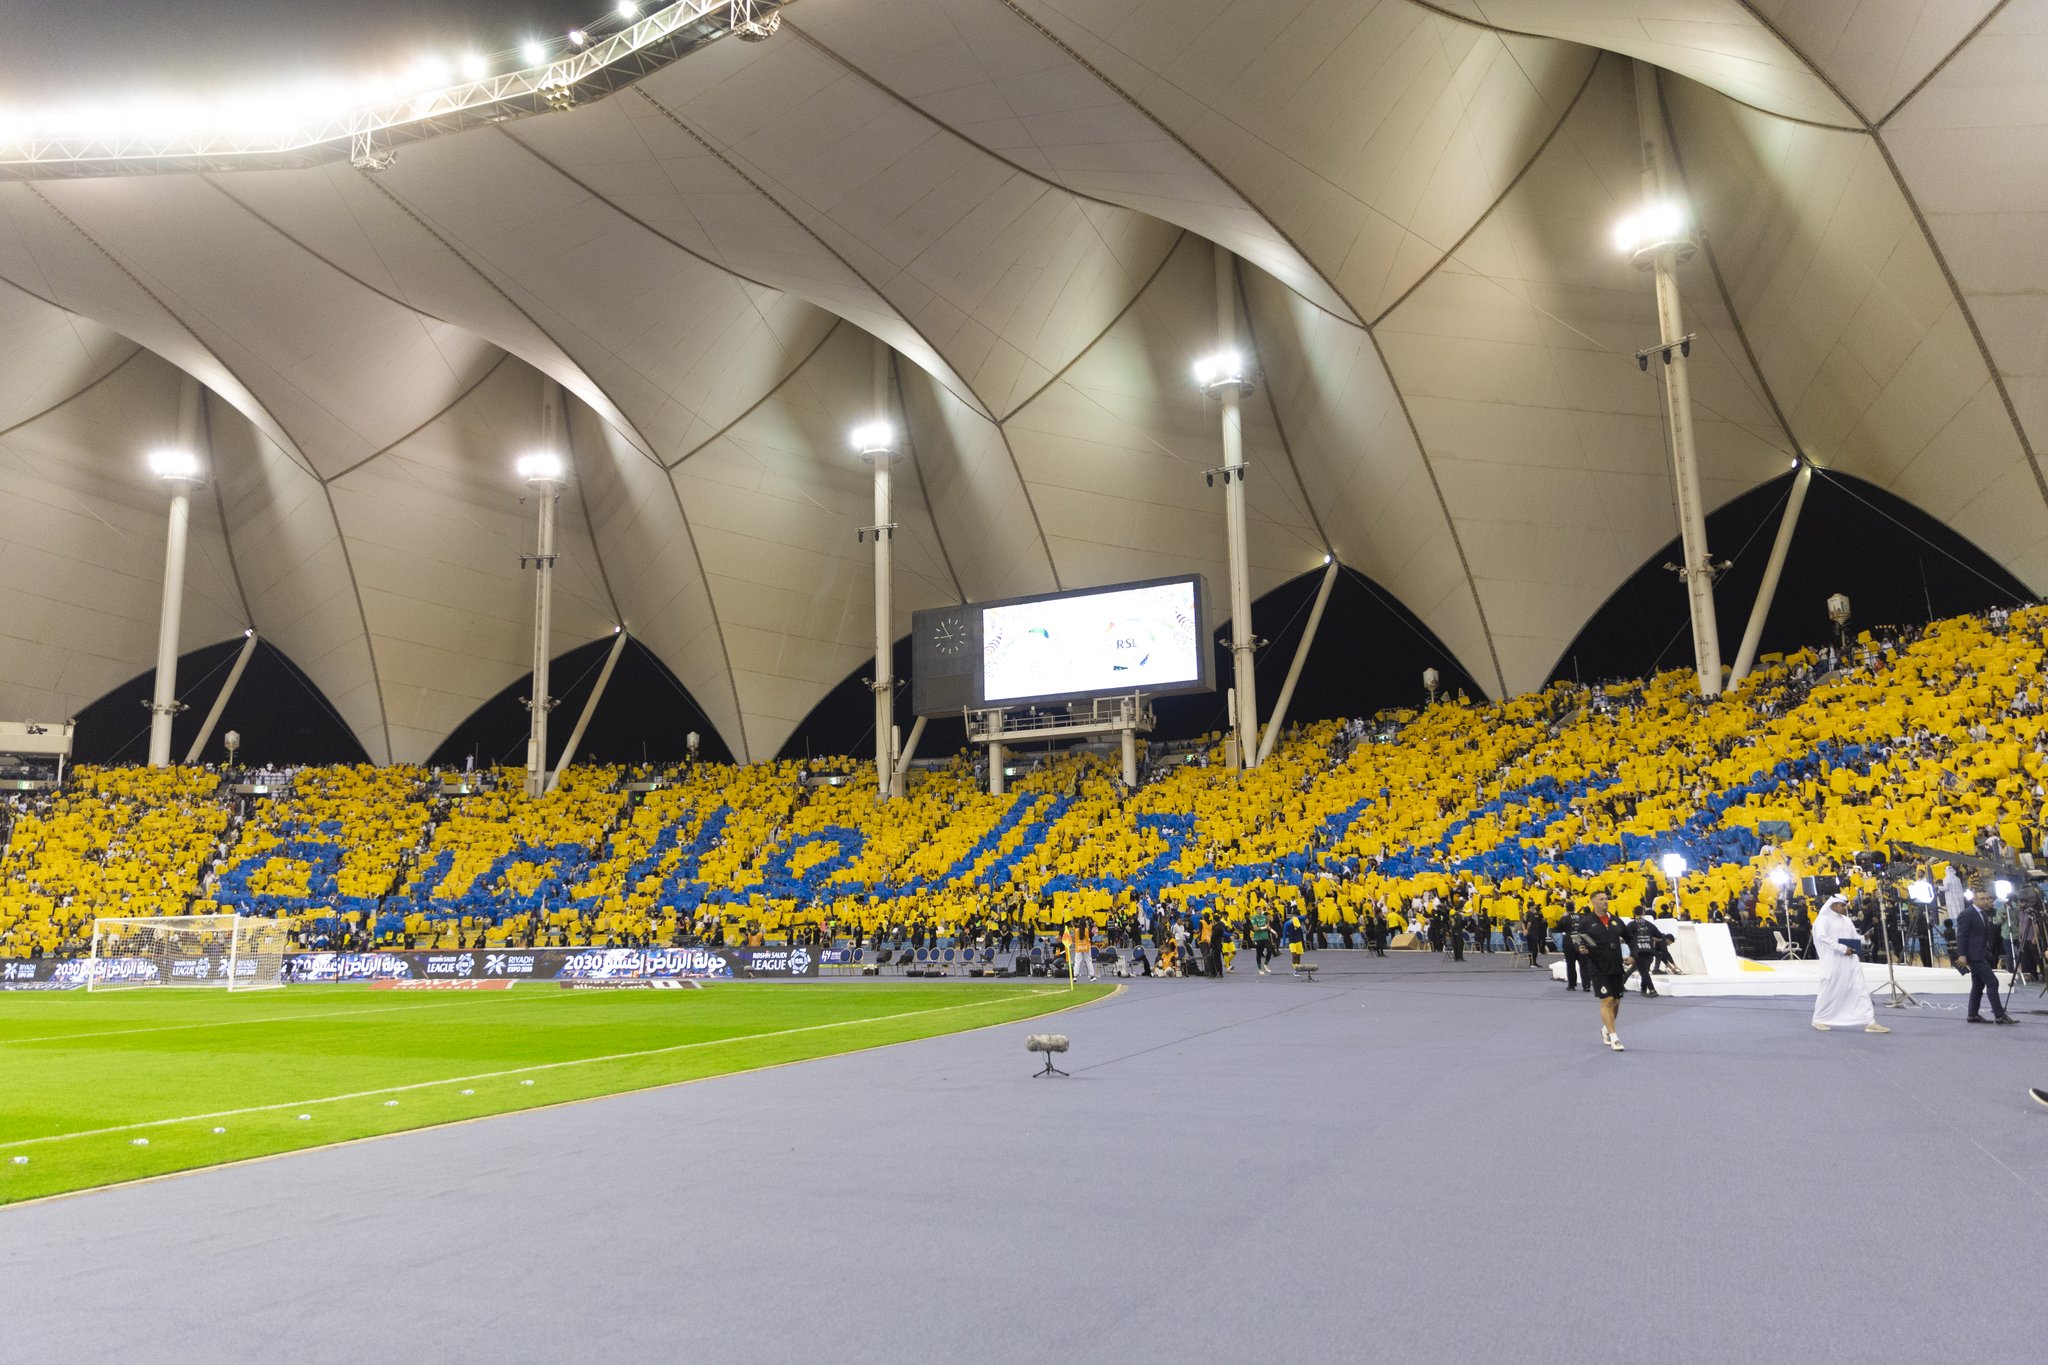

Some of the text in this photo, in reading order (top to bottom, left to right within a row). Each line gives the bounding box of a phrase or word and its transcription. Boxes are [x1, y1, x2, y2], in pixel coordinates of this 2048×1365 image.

[1116, 638, 1137, 650] RSL
[345, 956, 382, 976] الرياض
[508, 956, 535, 964] RIYADH
[565, 955, 602, 970] 2030
[646, 952, 692, 974] الرياض
[693, 952, 727, 974] جولة
[751, 959, 787, 971] LEAGUE
[55, 964, 80, 976] 2030
[172, 967, 195, 976] LEAGUE
[382, 957, 408, 976] جولة
[426, 963, 456, 973] LEAGUE
